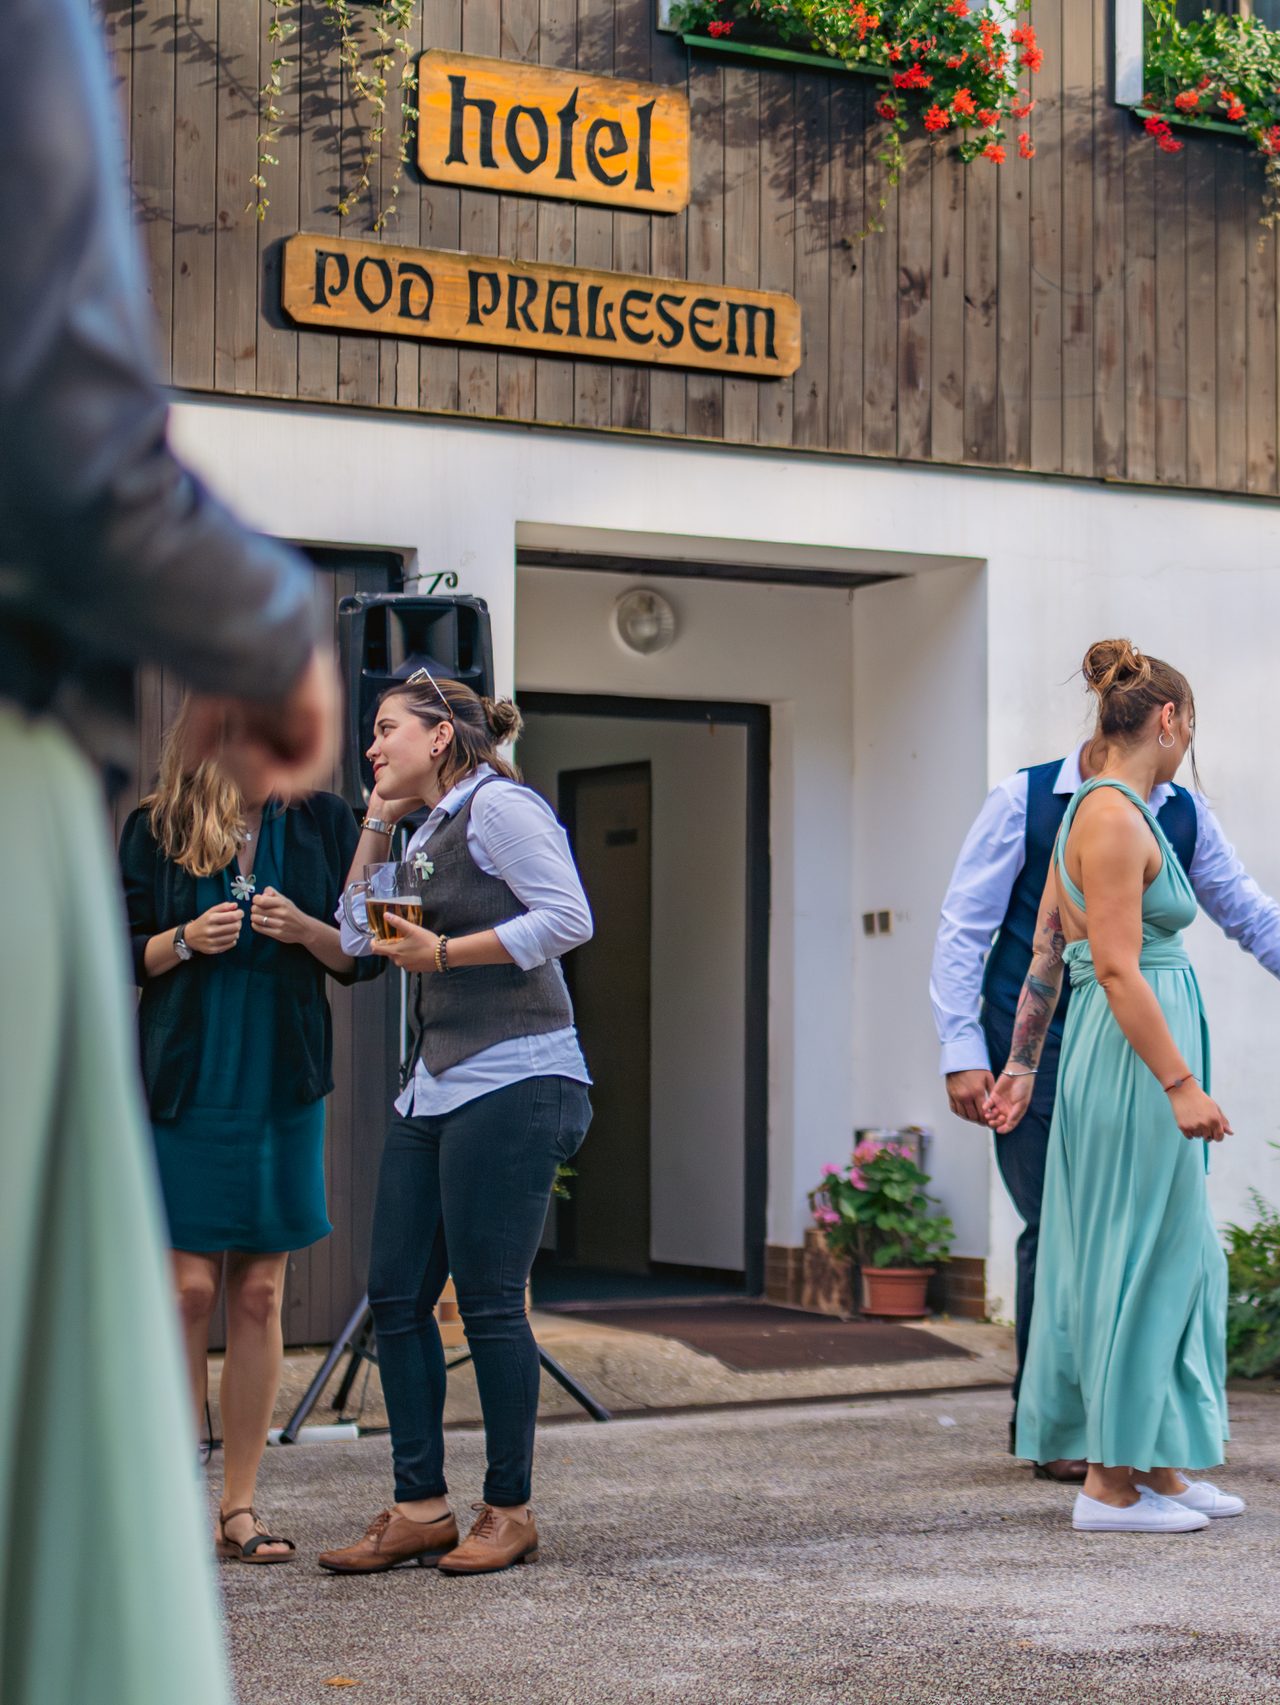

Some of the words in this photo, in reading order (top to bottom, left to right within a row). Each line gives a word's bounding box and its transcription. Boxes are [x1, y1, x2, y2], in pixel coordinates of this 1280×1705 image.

[445, 75, 656, 191] hotel
[312, 249, 434, 321] POD
[466, 269, 778, 359] PRALESEM
